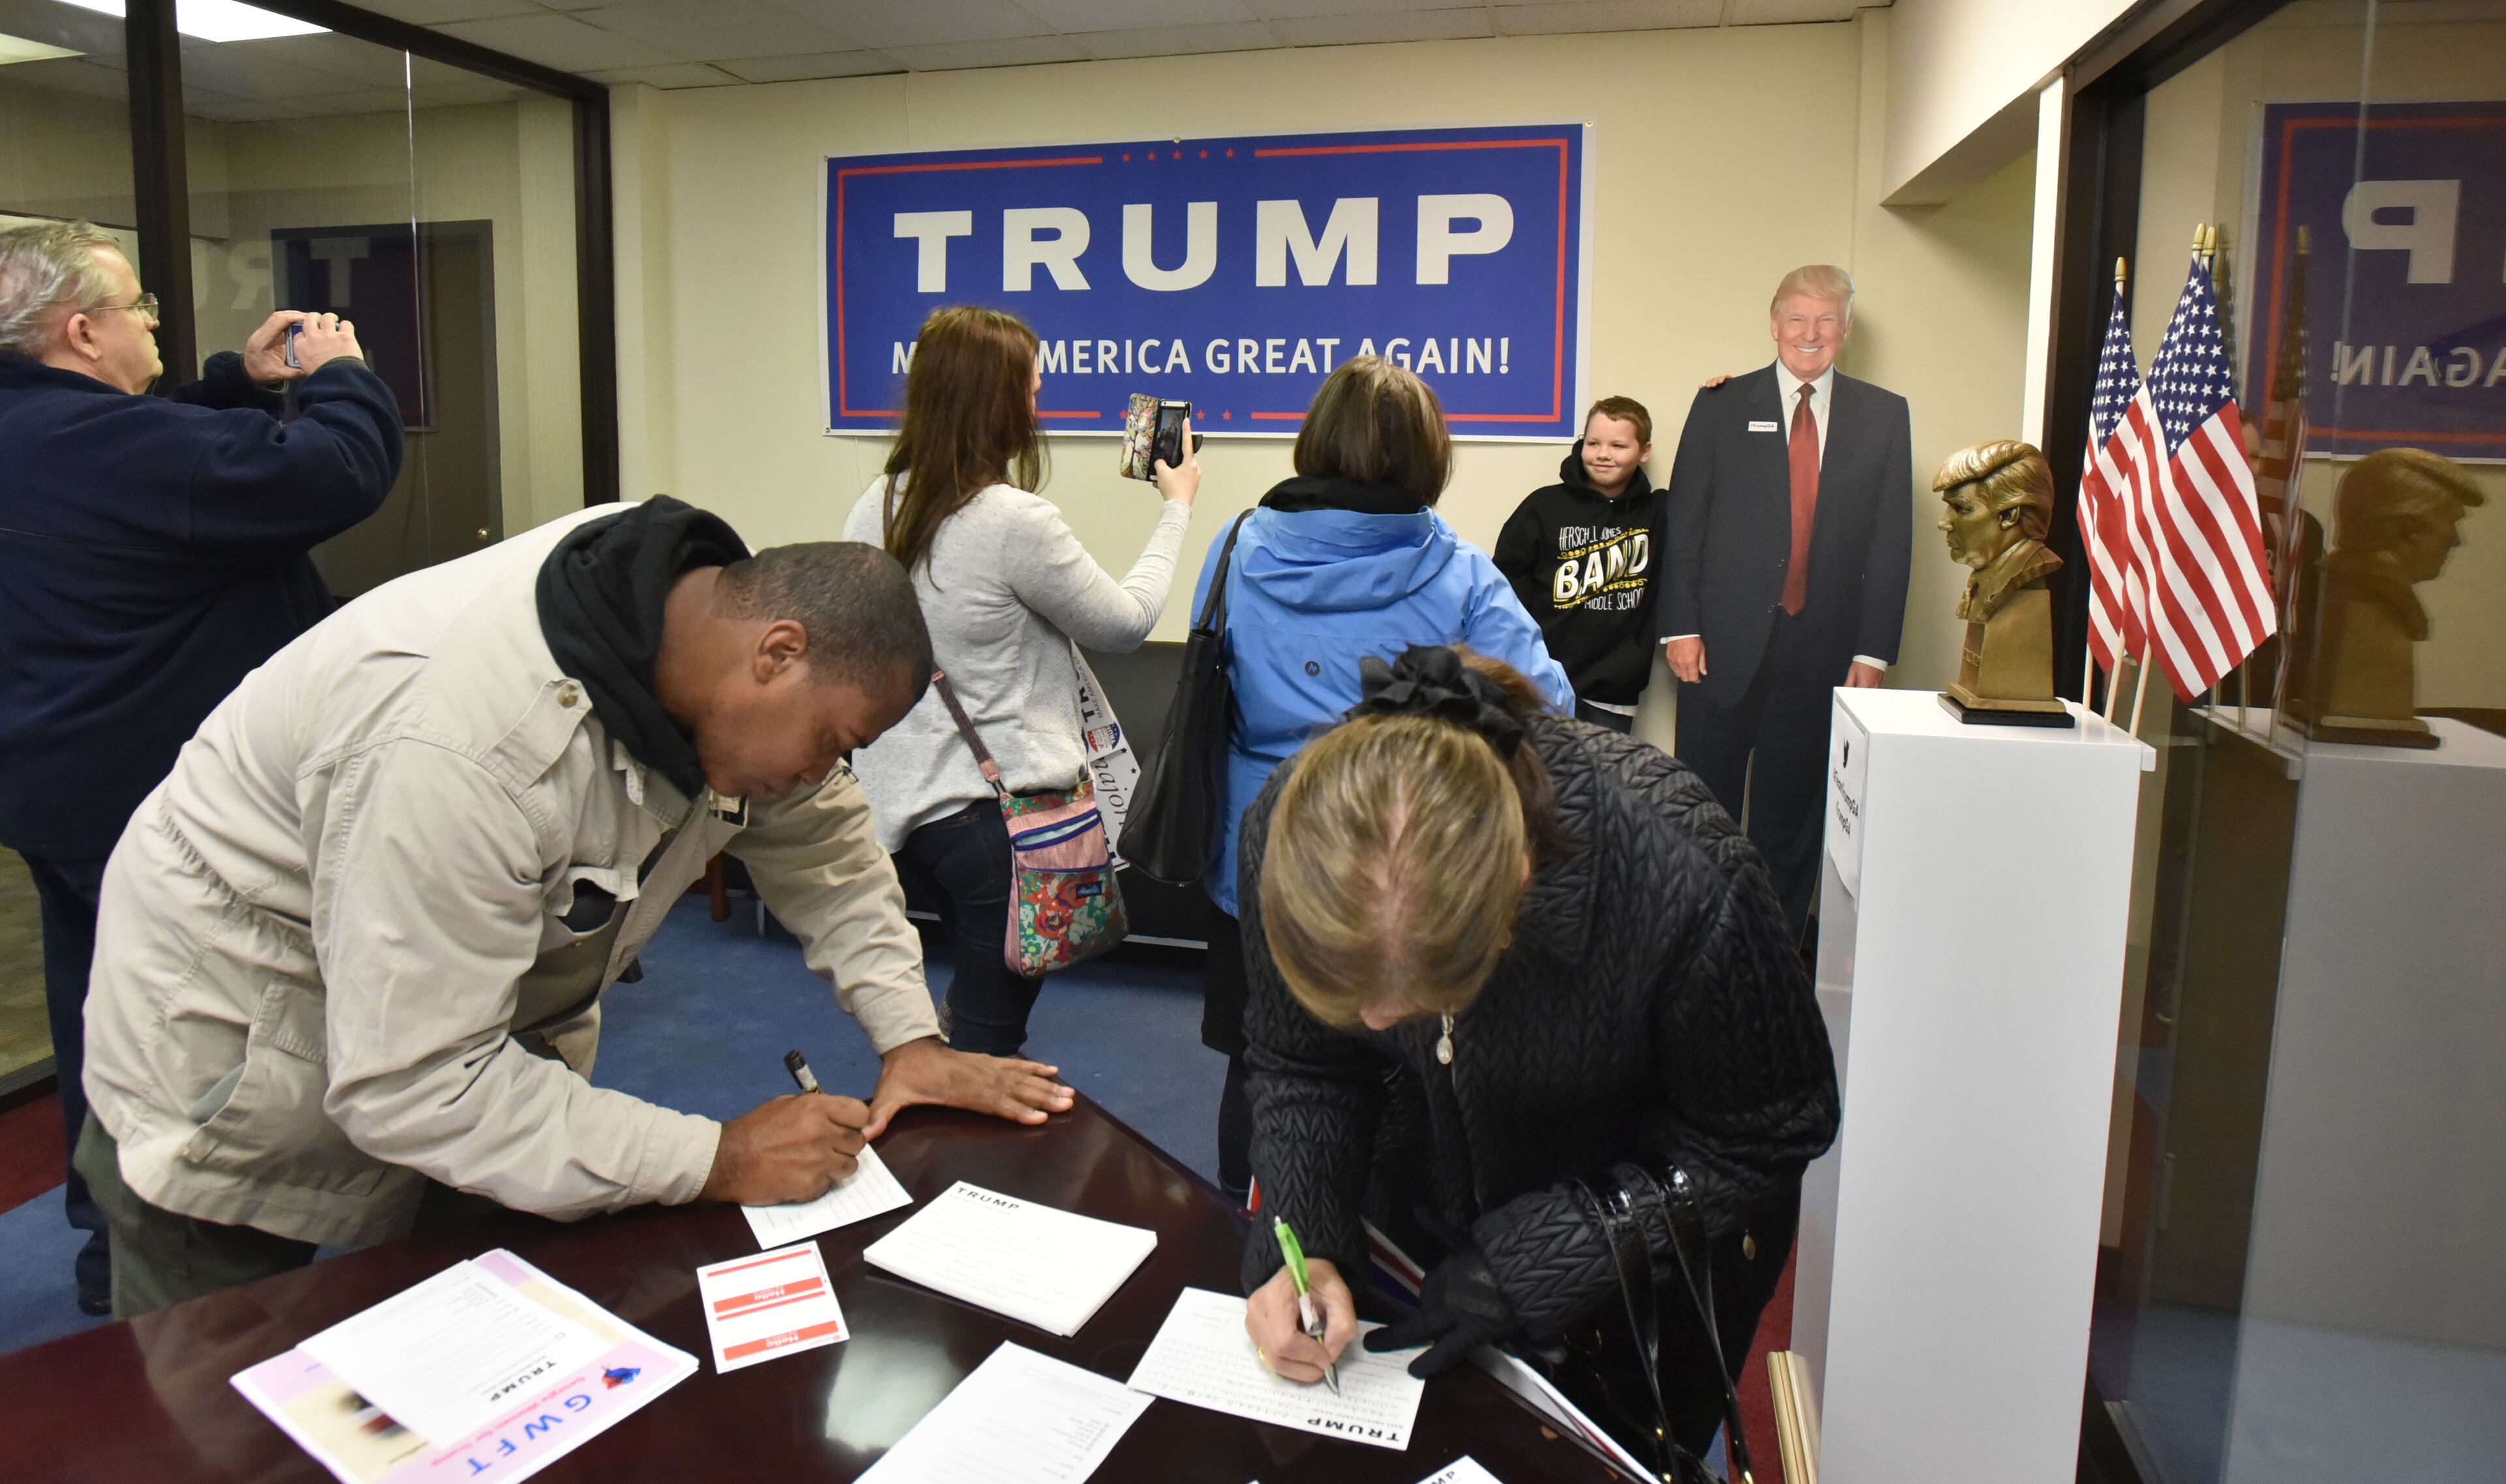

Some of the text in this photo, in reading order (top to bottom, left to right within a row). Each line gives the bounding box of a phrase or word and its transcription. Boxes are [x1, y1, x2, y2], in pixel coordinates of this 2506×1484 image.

[893, 193, 1514, 293] TRUMP
[1038, 339, 1192, 374] MERICA
[1205, 338, 1340, 374] GREAT
[1558, 525, 1599, 551] HERSCHL
[1553, 533, 1650, 602] BAND
[1584, 587, 1645, 611] MIDDLE SCHOO
[957, 1186, 1021, 1209] TRUMP
[753, 1288, 786, 1301] Hello
[766, 1334, 799, 1348] Hello
[489, 1359, 557, 1402] TRUMP
[1307, 1417, 1400, 1442] TRUMP
